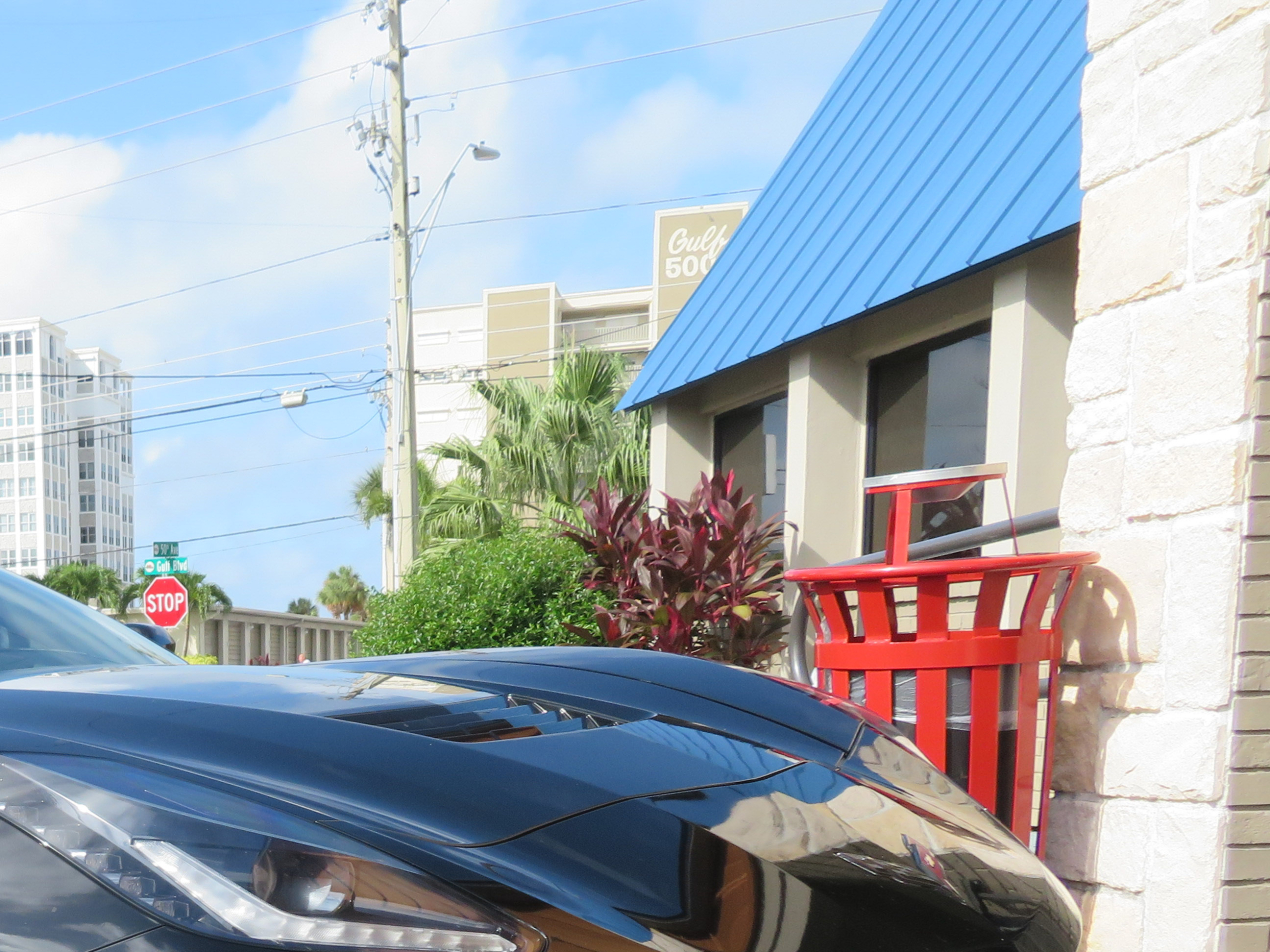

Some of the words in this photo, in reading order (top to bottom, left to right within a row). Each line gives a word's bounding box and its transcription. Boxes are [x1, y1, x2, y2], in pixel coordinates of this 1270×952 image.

[668, 224, 730, 260] Gulf
[156, 560, 171, 573] Gulf
[172, 559, 188, 572] Blvd
[147, 593, 184, 613] STOP
